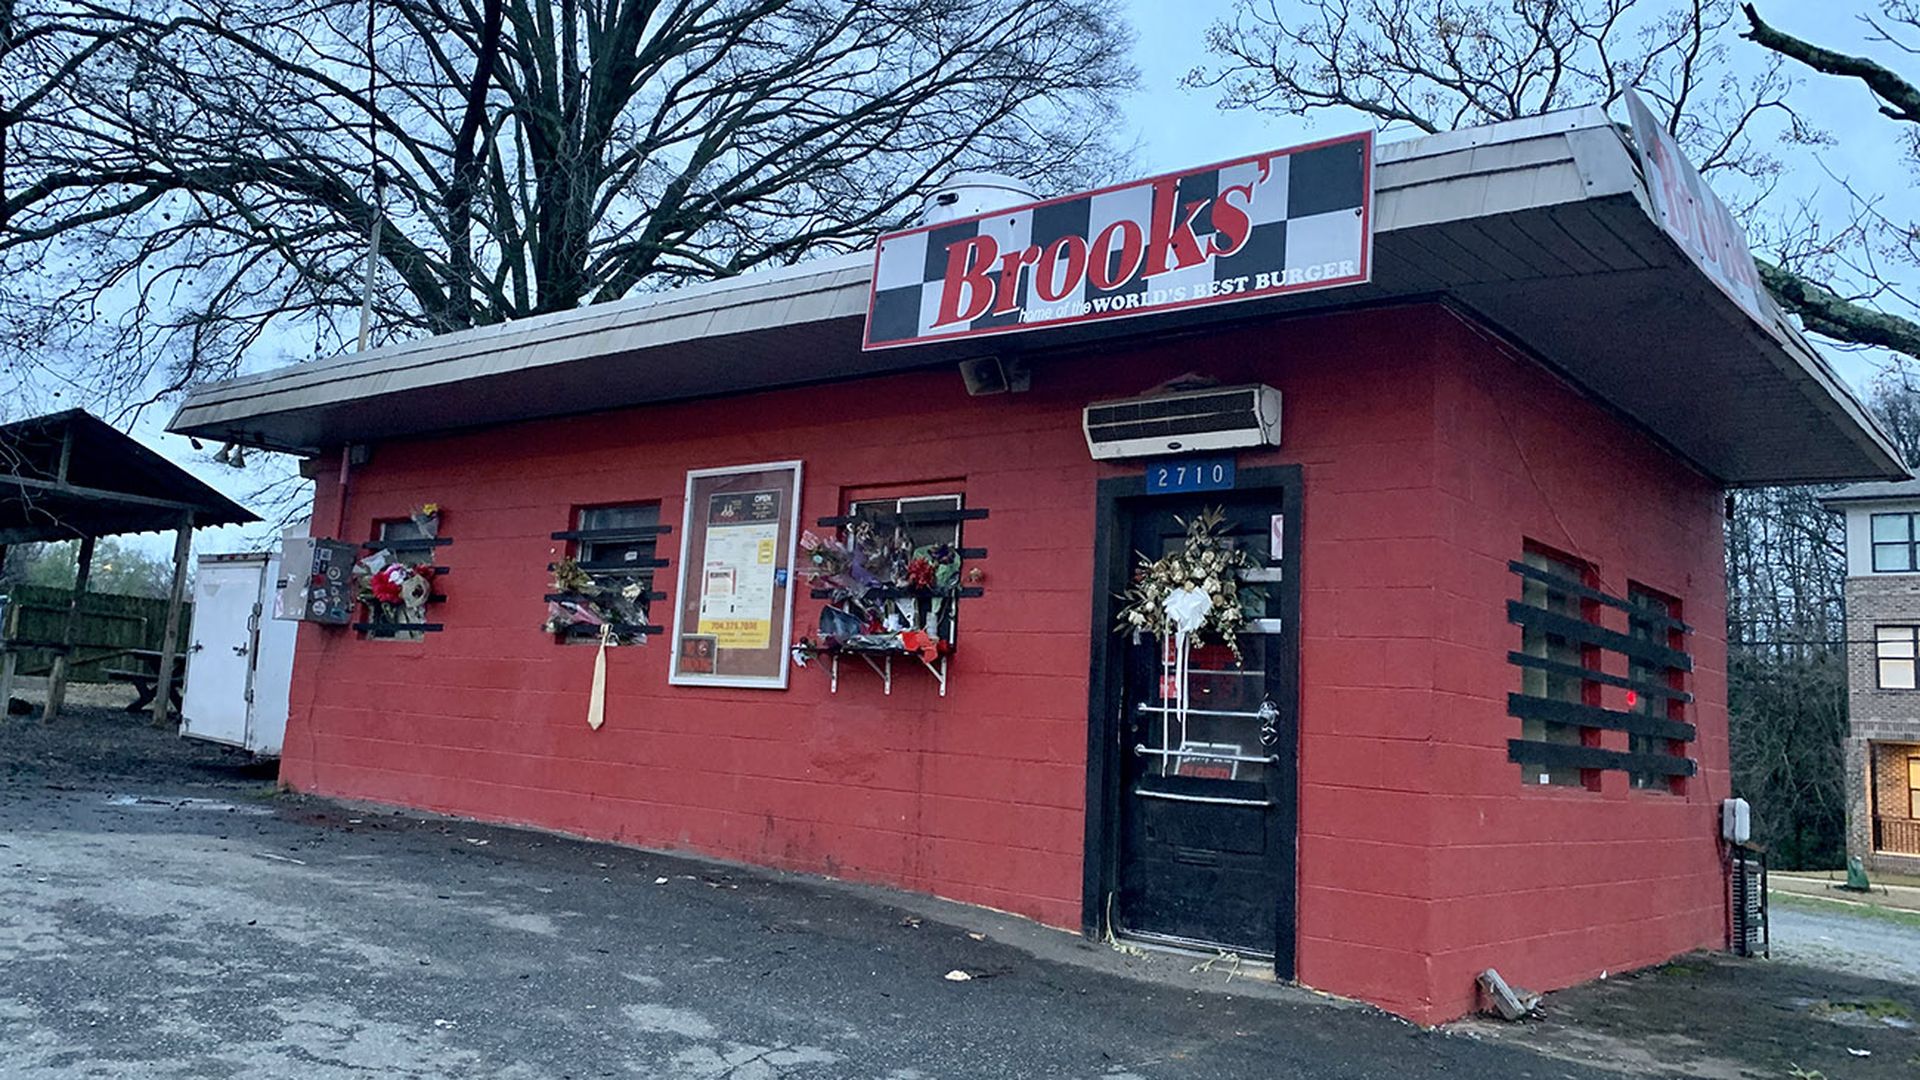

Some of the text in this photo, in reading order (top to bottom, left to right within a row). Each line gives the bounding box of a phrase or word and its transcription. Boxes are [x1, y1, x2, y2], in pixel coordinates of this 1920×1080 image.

[930, 158, 1271, 328] Brooks'
[1018, 260, 1356, 323] home of the WORLD'S BEST BURGER
[1158, 464, 1223, 487] 2710
[754, 494, 772, 503] OPEN
